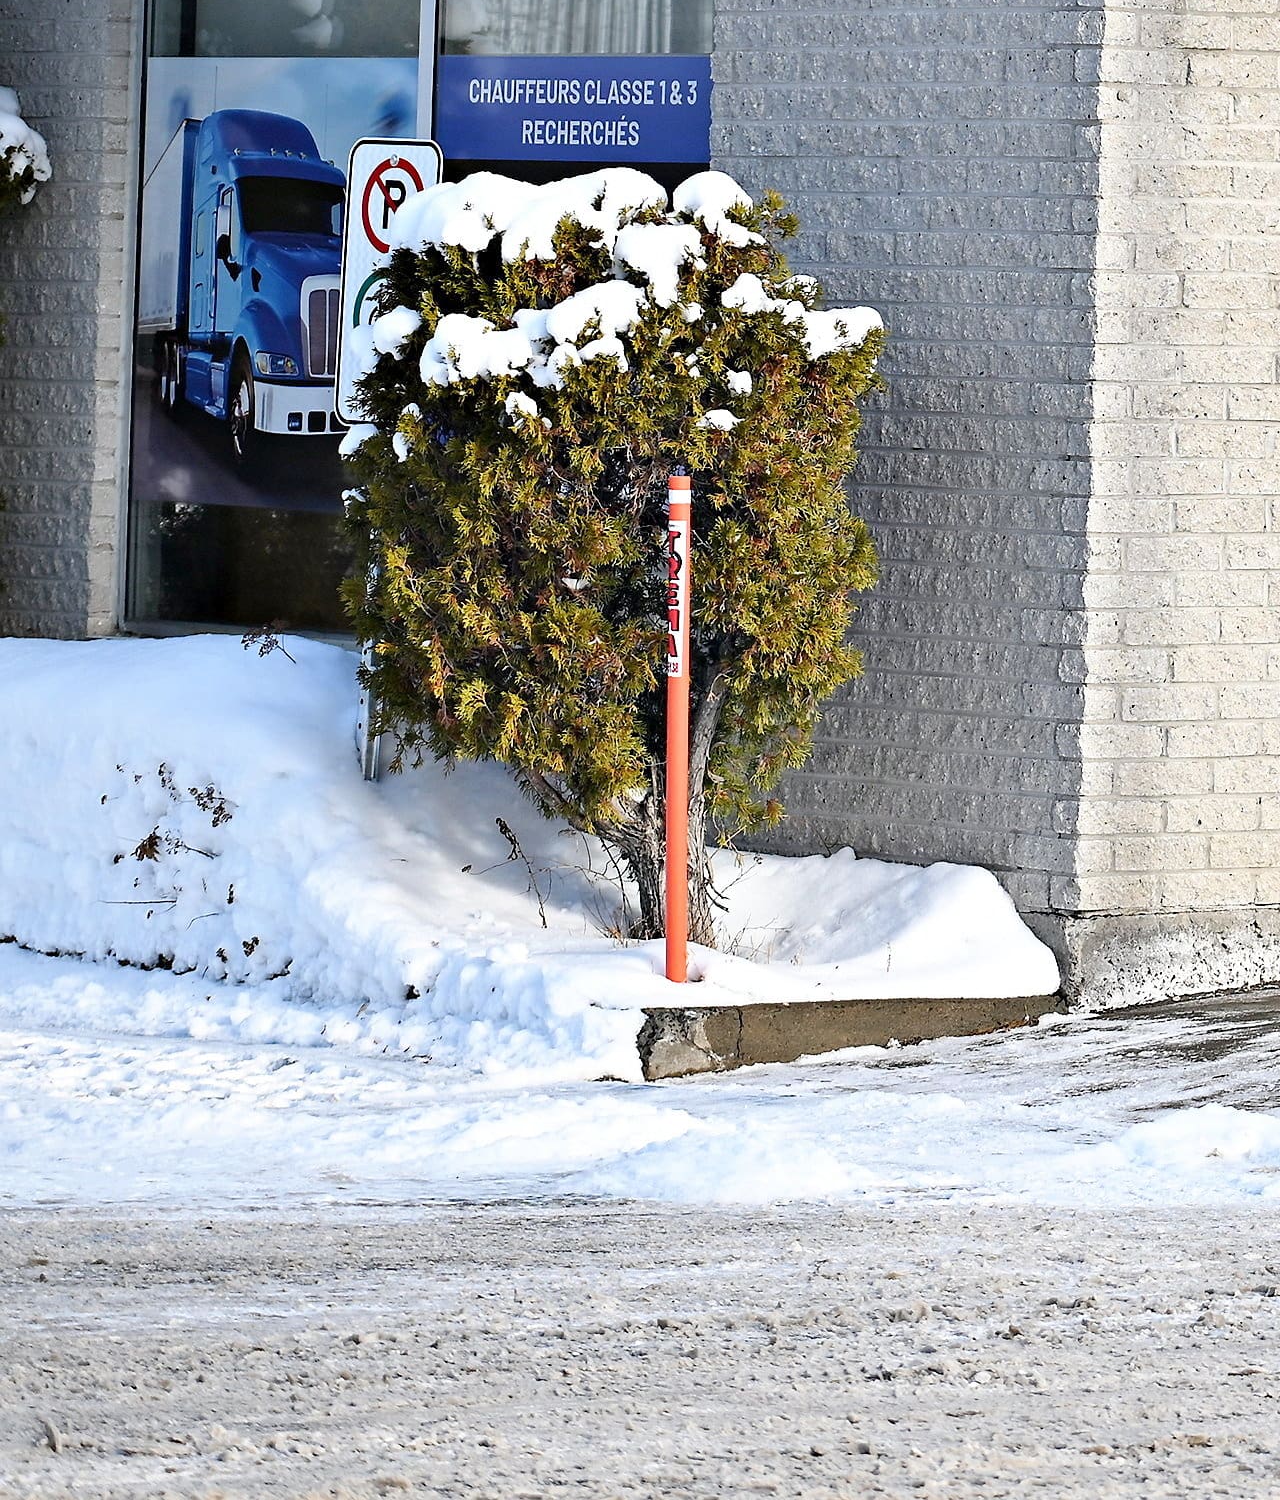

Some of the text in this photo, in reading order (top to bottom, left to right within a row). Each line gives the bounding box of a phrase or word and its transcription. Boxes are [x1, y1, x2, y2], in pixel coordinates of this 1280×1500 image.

[469, 79, 698, 105] CHAUFFEURS CLASSE 1 & 3
[522, 115, 640, 146] RECHERCHÉS
